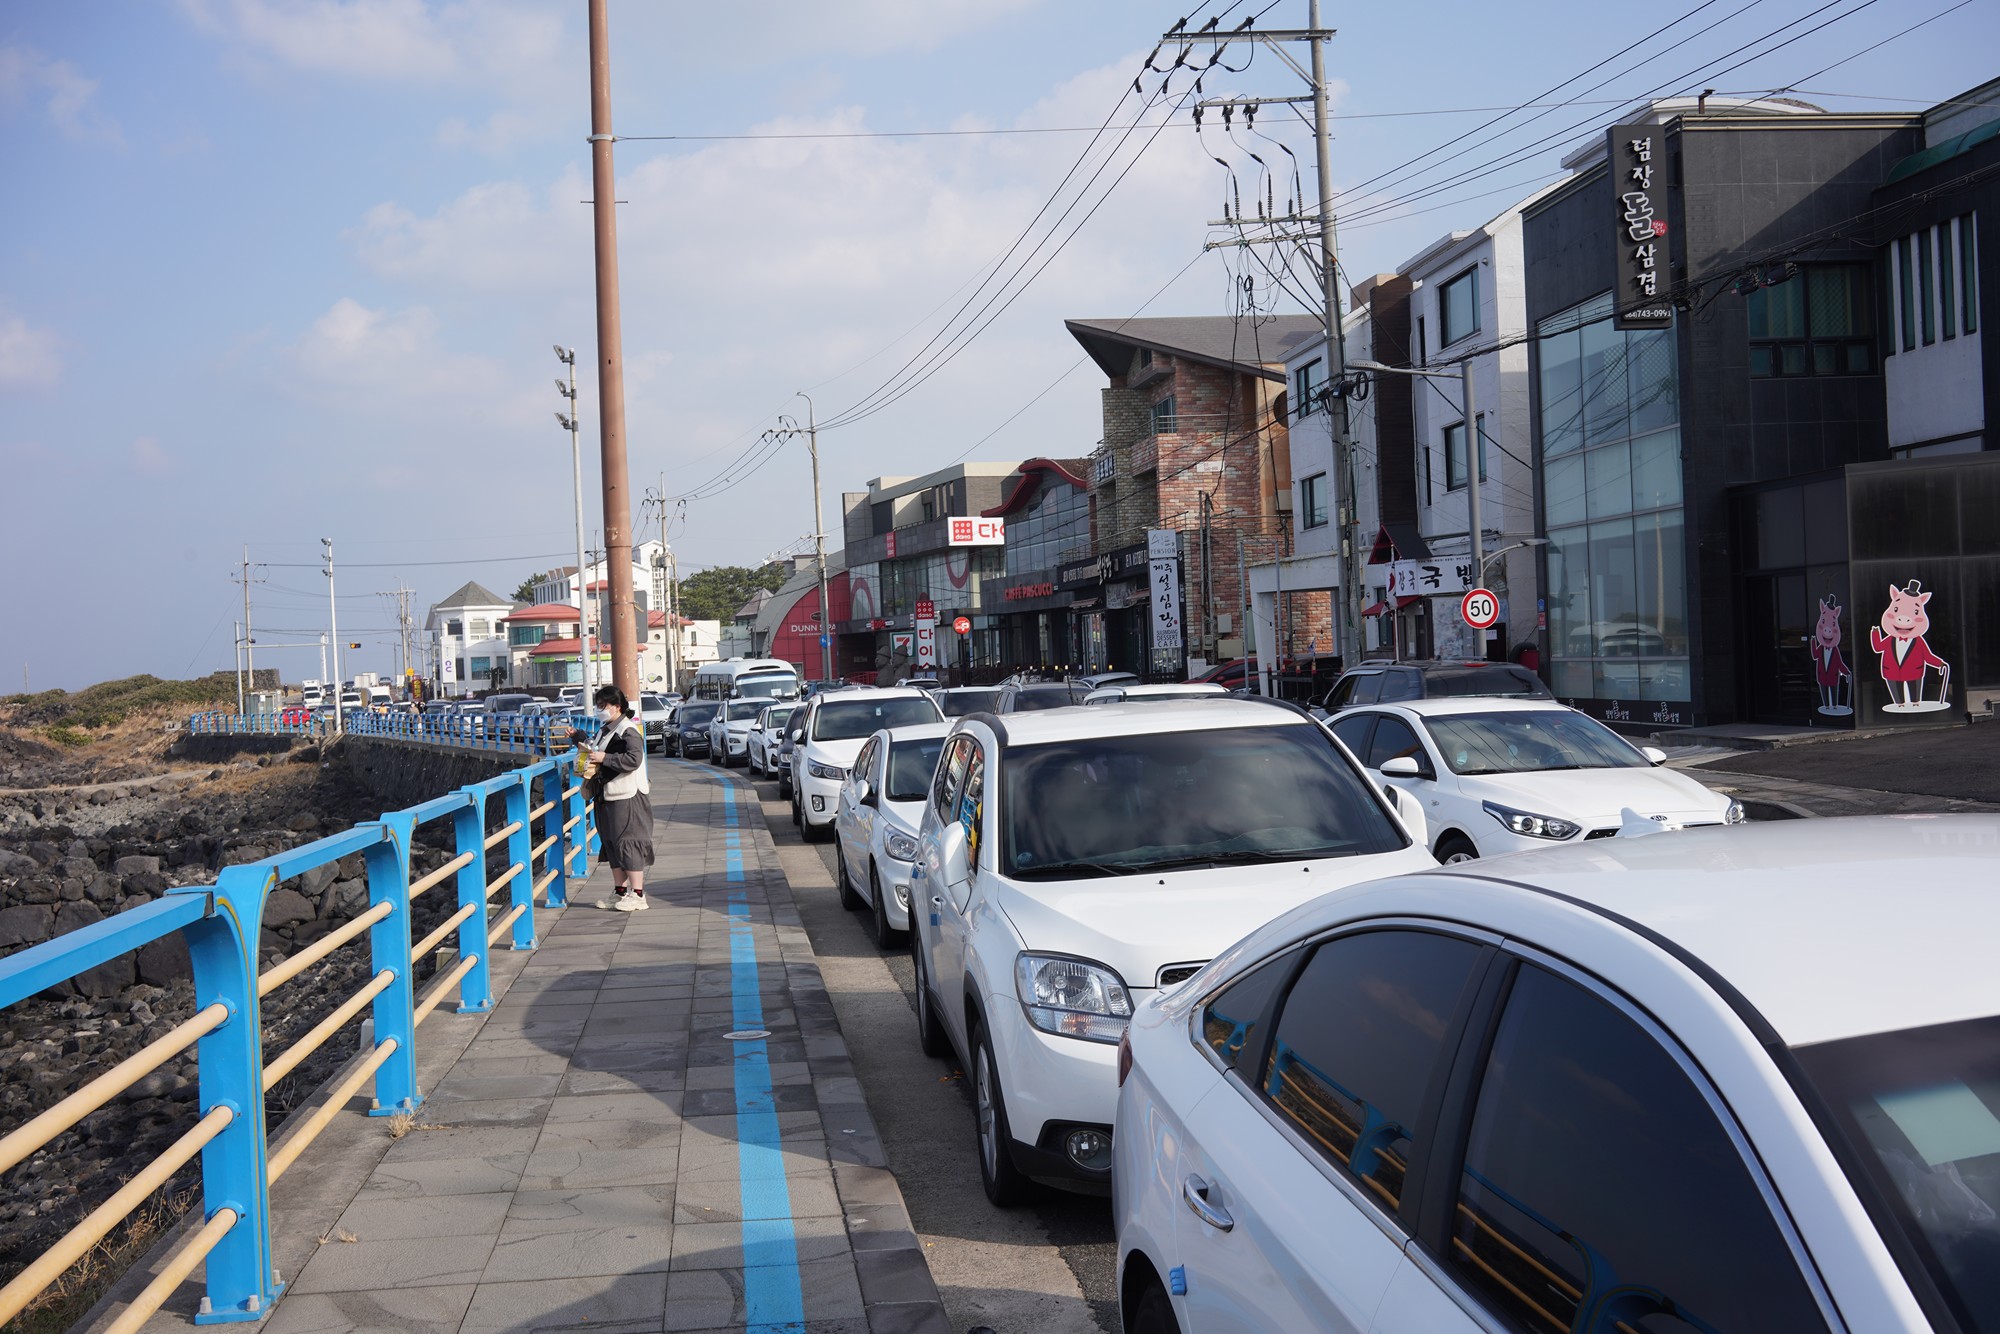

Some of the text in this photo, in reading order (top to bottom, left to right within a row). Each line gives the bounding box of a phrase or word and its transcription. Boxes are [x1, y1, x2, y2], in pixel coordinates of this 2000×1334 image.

[1023, 582, 1053, 598] PASCUCCI
[1470, 599, 1492, 617] 50
[791, 624, 818, 632] DUNN
[1157, 640, 1178, 648] CAFE
